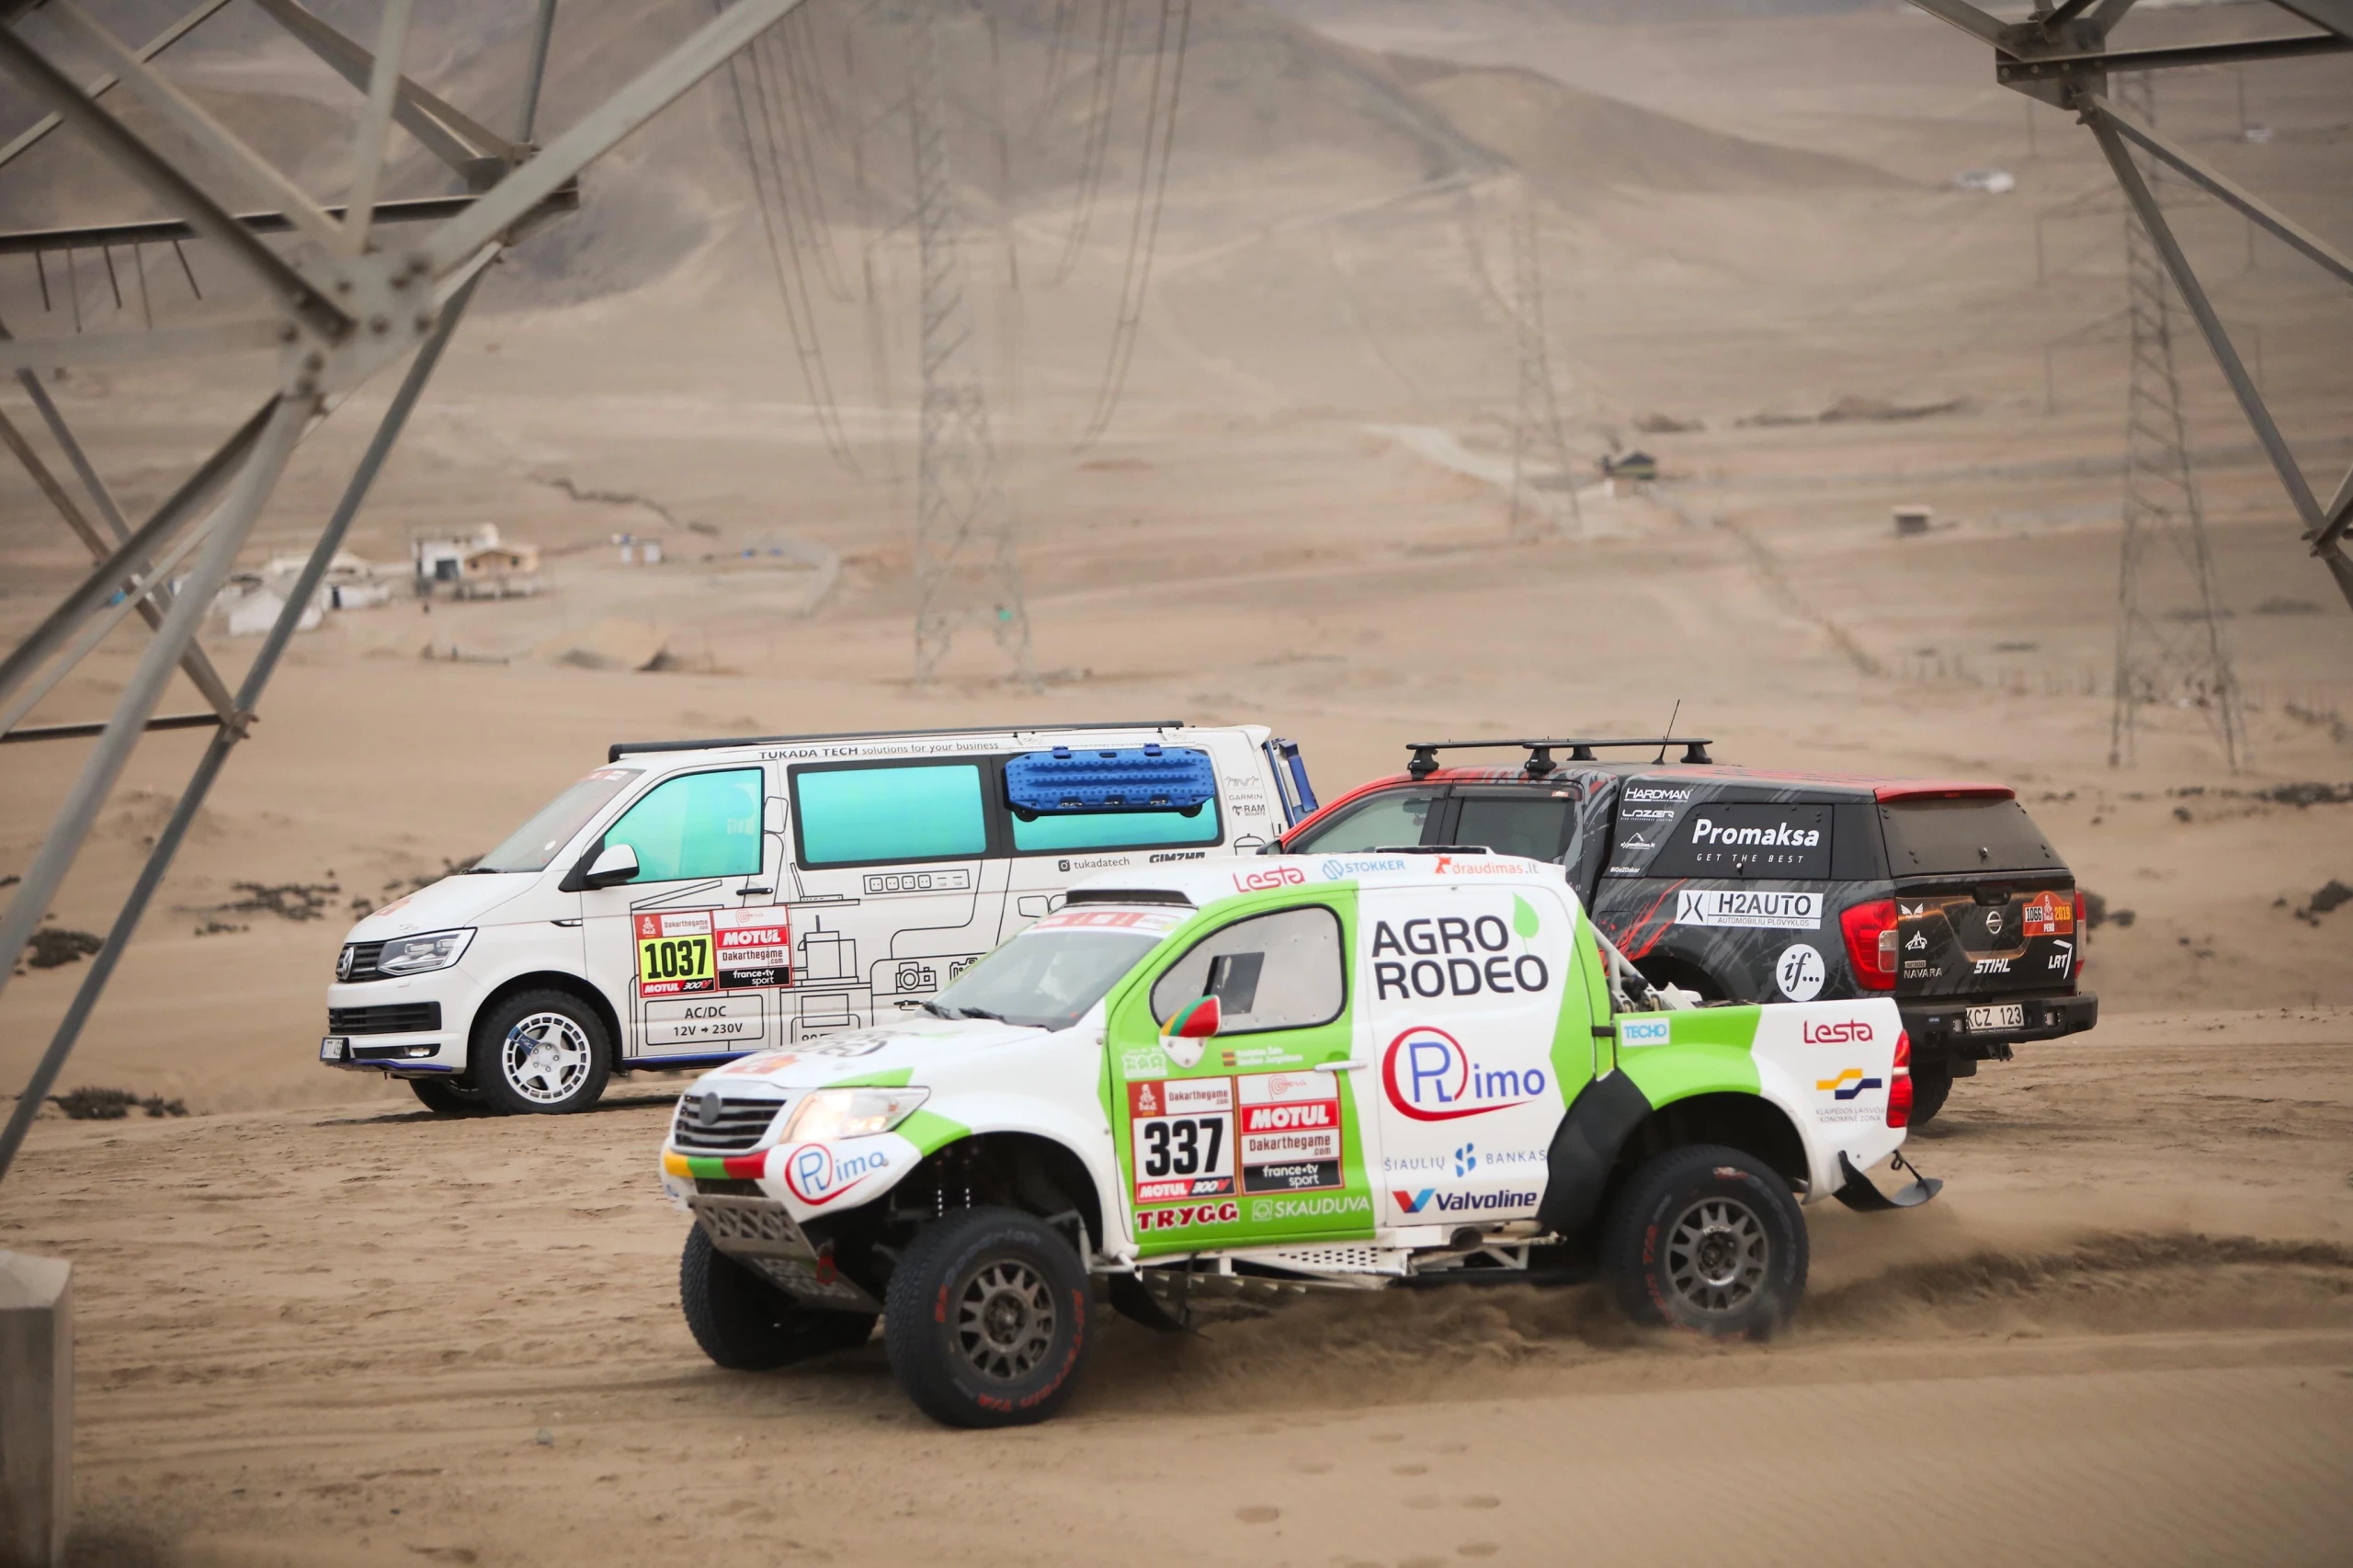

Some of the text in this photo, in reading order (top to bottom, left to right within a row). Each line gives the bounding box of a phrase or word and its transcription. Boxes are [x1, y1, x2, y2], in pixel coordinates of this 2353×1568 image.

[759, 741, 999, 759] TUKADA TECH solutions for your business
[1625, 788, 1690, 800] HARDMAN
[1244, 804, 1266, 812] RAM
[1692, 819, 1820, 846] Promaksa
[1074, 857, 1131, 869] tukadatech
[1346, 859, 1405, 873] STOKKER
[1697, 854, 1804, 864] GET THE BEST
[1452, 861, 1540, 874] draudimas.lt
[1233, 865, 1306, 892] Lesta
[1718, 892, 1812, 916] H2AUTO
[2026, 907, 2042, 922] 1066
[2054, 906, 2071, 921] 2019
[722, 929, 781, 947] MOTUL
[1371, 915, 1509, 958] AGRO
[644, 939, 707, 979] 1037
[722, 949, 783, 961] Dakarthegame
[2048, 954, 2068, 970] LRT
[1904, 968, 1942, 979] NAVARA
[1973, 958, 2011, 974] STIHL
[683, 980, 713, 991] 300V
[752, 976, 775, 986] sport
[1374, 954, 1549, 1001] RODEO
[644, 983, 680, 994] MOTUL
[685, 1006, 727, 1019] AC/DC
[1967, 1006, 2022, 1028] KCZ 123
[674, 1023, 744, 1037] 12V 230V
[1624, 1023, 1667, 1039] TECHO
[1803, 1018, 1873, 1044] Lesta
[1168, 1089, 1229, 1102] Dakarthegame
[1250, 1105, 1330, 1130] MOTUL
[1144, 1117, 1223, 1177] 337
[1249, 1134, 1331, 1152] Dakarthegame
[1313, 1147, 1331, 1155] .com
[1485, 1150, 1547, 1165] BANKAS
[1192, 1178, 1231, 1195] 300V
[1289, 1174, 1320, 1189] sport
[1140, 1181, 1188, 1199] MOTUL
[1275, 1197, 1370, 1218] SKAUDUVA
[1435, 1190, 1537, 1213] Valvoline
[1136, 1203, 1240, 1231] TRYGG
